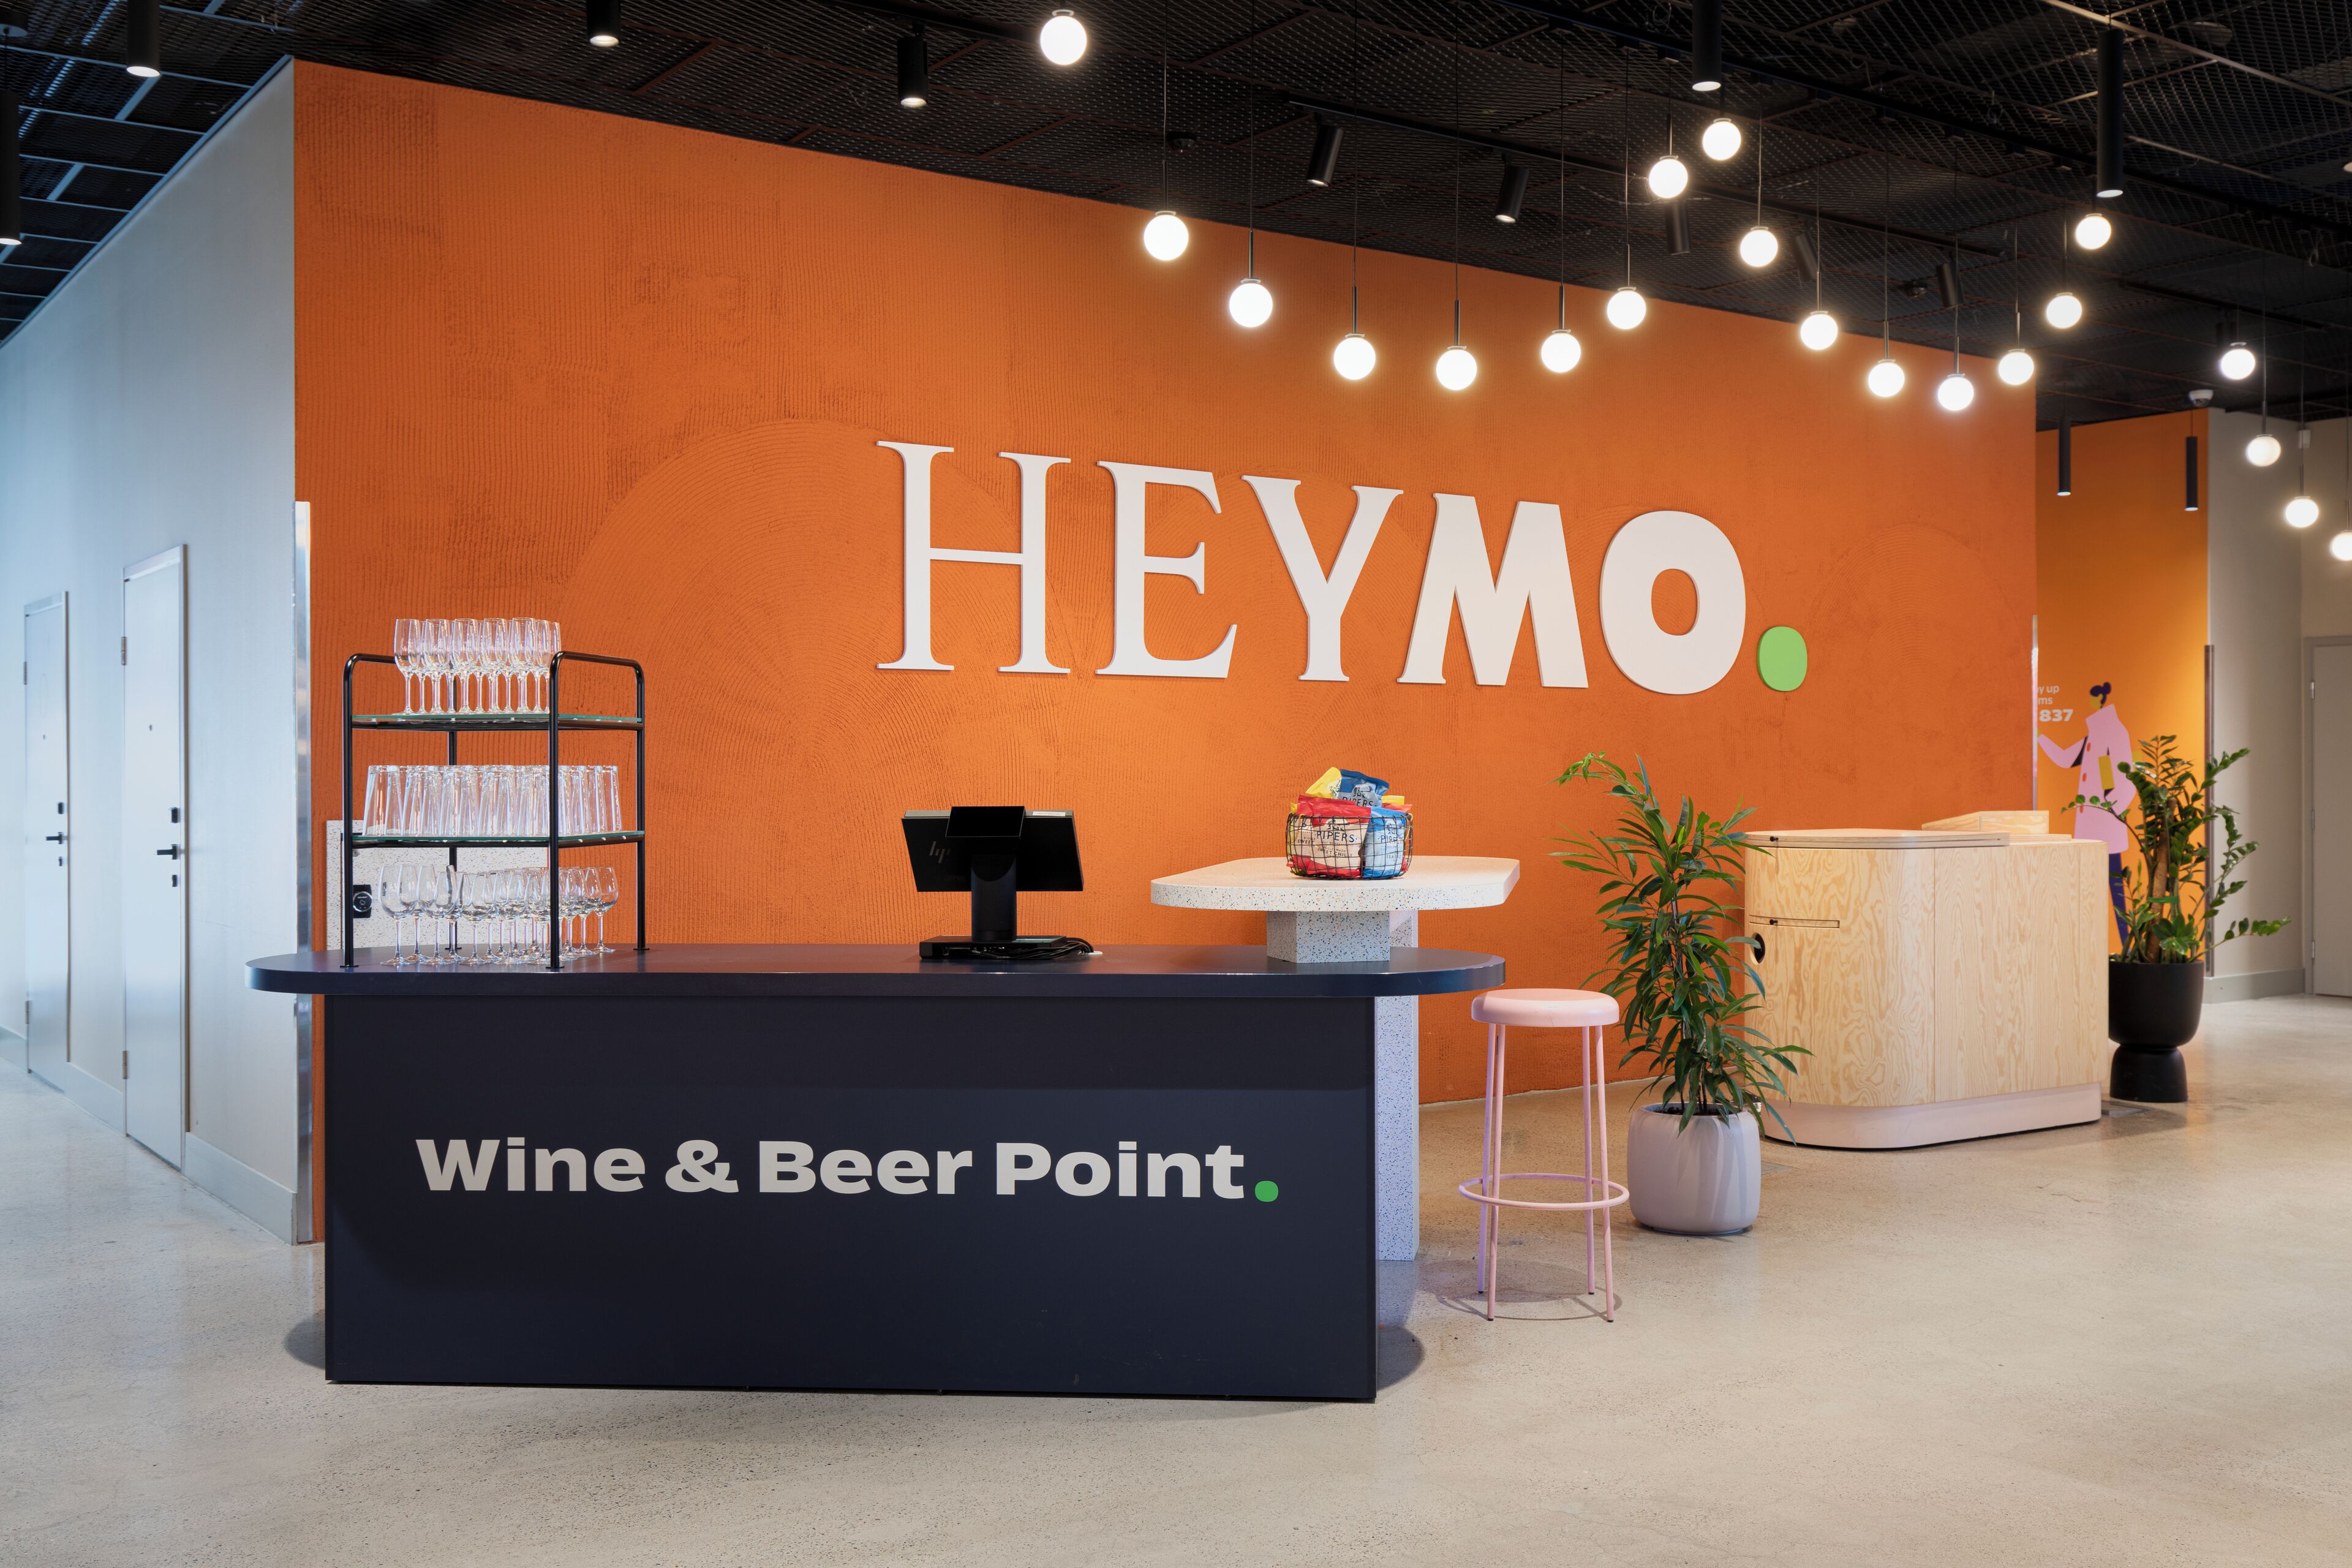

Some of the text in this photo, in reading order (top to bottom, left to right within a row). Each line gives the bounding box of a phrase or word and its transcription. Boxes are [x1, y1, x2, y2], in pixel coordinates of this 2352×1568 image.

[876, 441, 1807, 695] HEYMO.
[2046, 685, 2060, 695] up
[2039, 709, 2074, 722] 837
[1317, 831, 1355, 843] PIPERS
[416, 1137, 1279, 1202] Wine & Beer Point.
